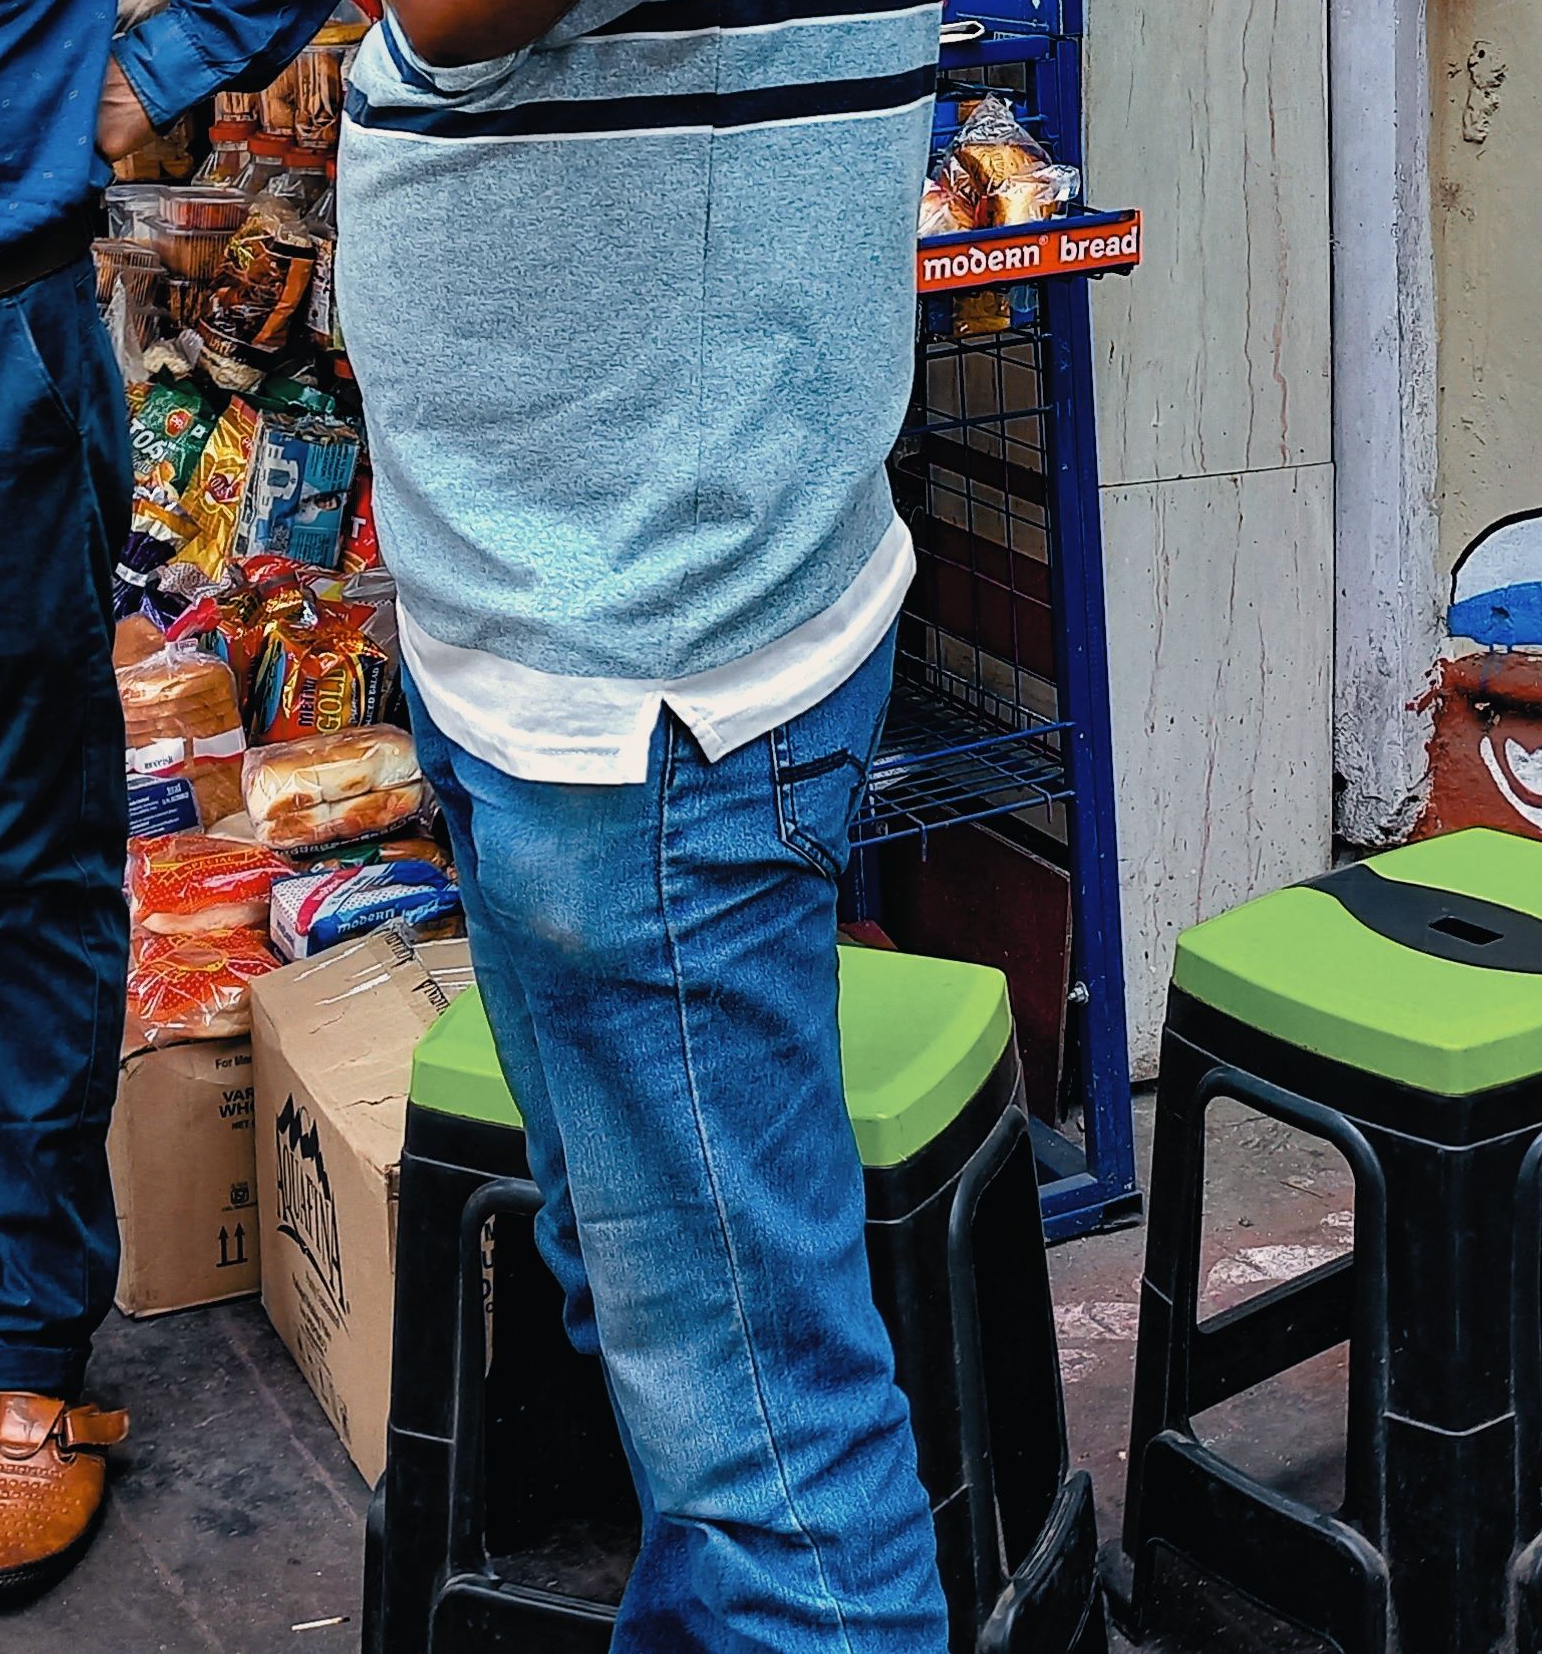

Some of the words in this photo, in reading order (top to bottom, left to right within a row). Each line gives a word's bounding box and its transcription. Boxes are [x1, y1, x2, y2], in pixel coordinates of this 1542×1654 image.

[923, 243, 1040, 281] modern
[1060, 226, 1138, 264] bread
[316, 669, 347, 735] GOLD
[336, 909, 395, 934] modern
[215, 1057, 232, 1070] For
